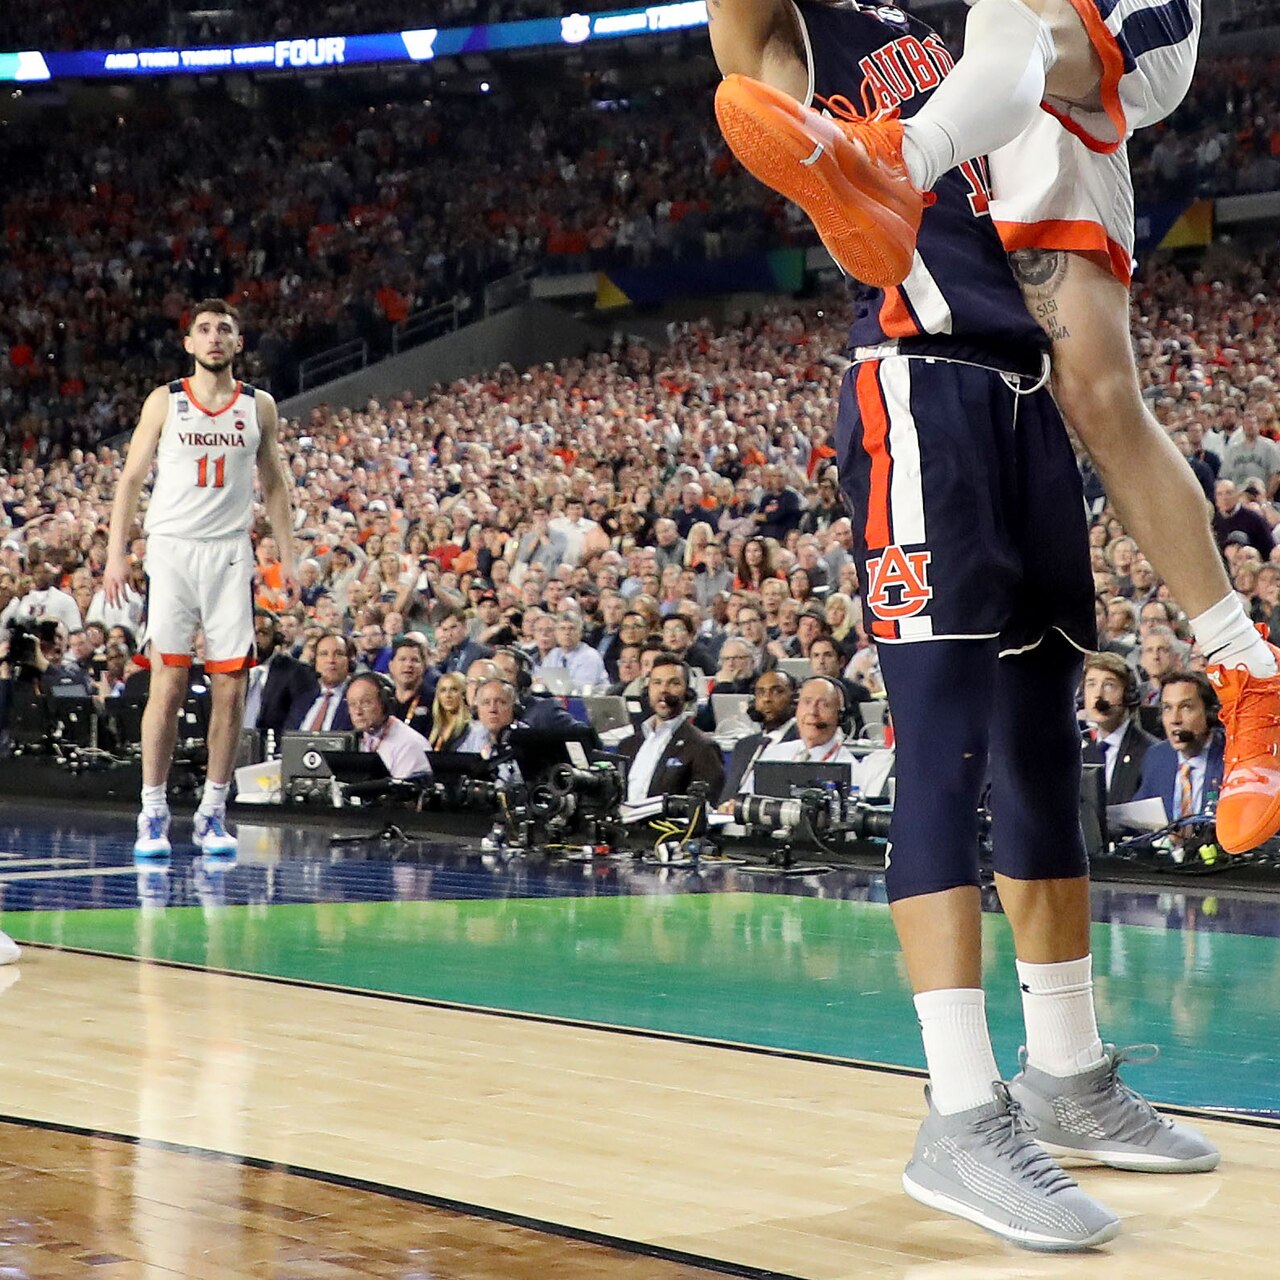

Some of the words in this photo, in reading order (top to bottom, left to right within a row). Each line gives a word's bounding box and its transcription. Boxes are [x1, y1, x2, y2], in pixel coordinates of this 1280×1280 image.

[275, 36, 346, 68] FOUR
[1036, 299, 1058, 318] SISI
[178, 431, 247, 448] VIRGINIA
[194, 452, 226, 489] 11
